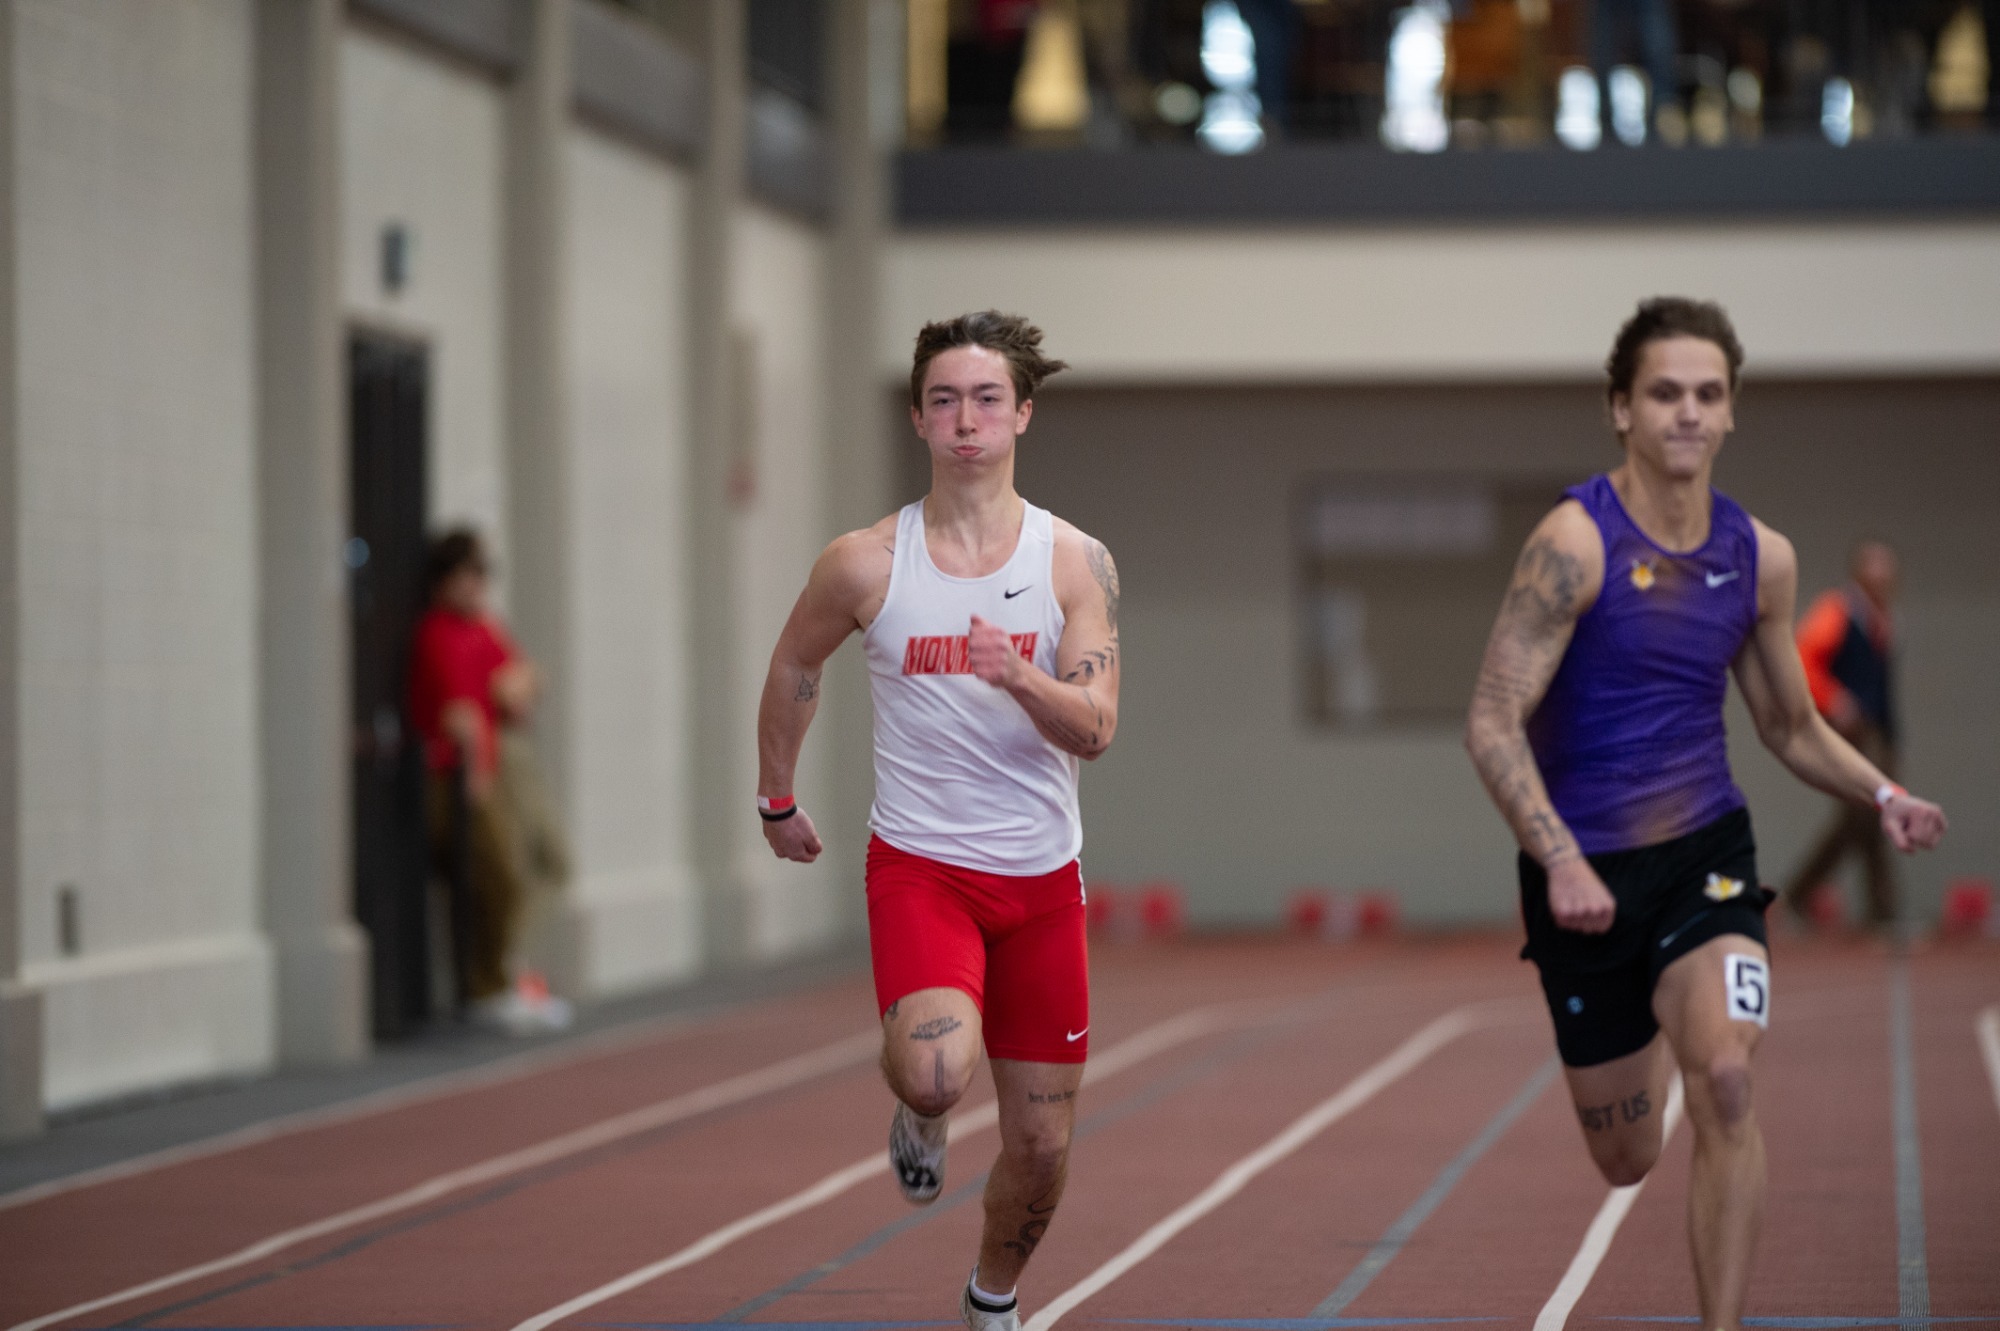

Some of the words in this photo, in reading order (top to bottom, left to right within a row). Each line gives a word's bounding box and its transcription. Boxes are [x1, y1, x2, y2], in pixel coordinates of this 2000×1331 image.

[902, 631, 1038, 675] MONMTH
[1736, 963, 1764, 1015] 5
[1621, 1090, 1652, 1125] US
